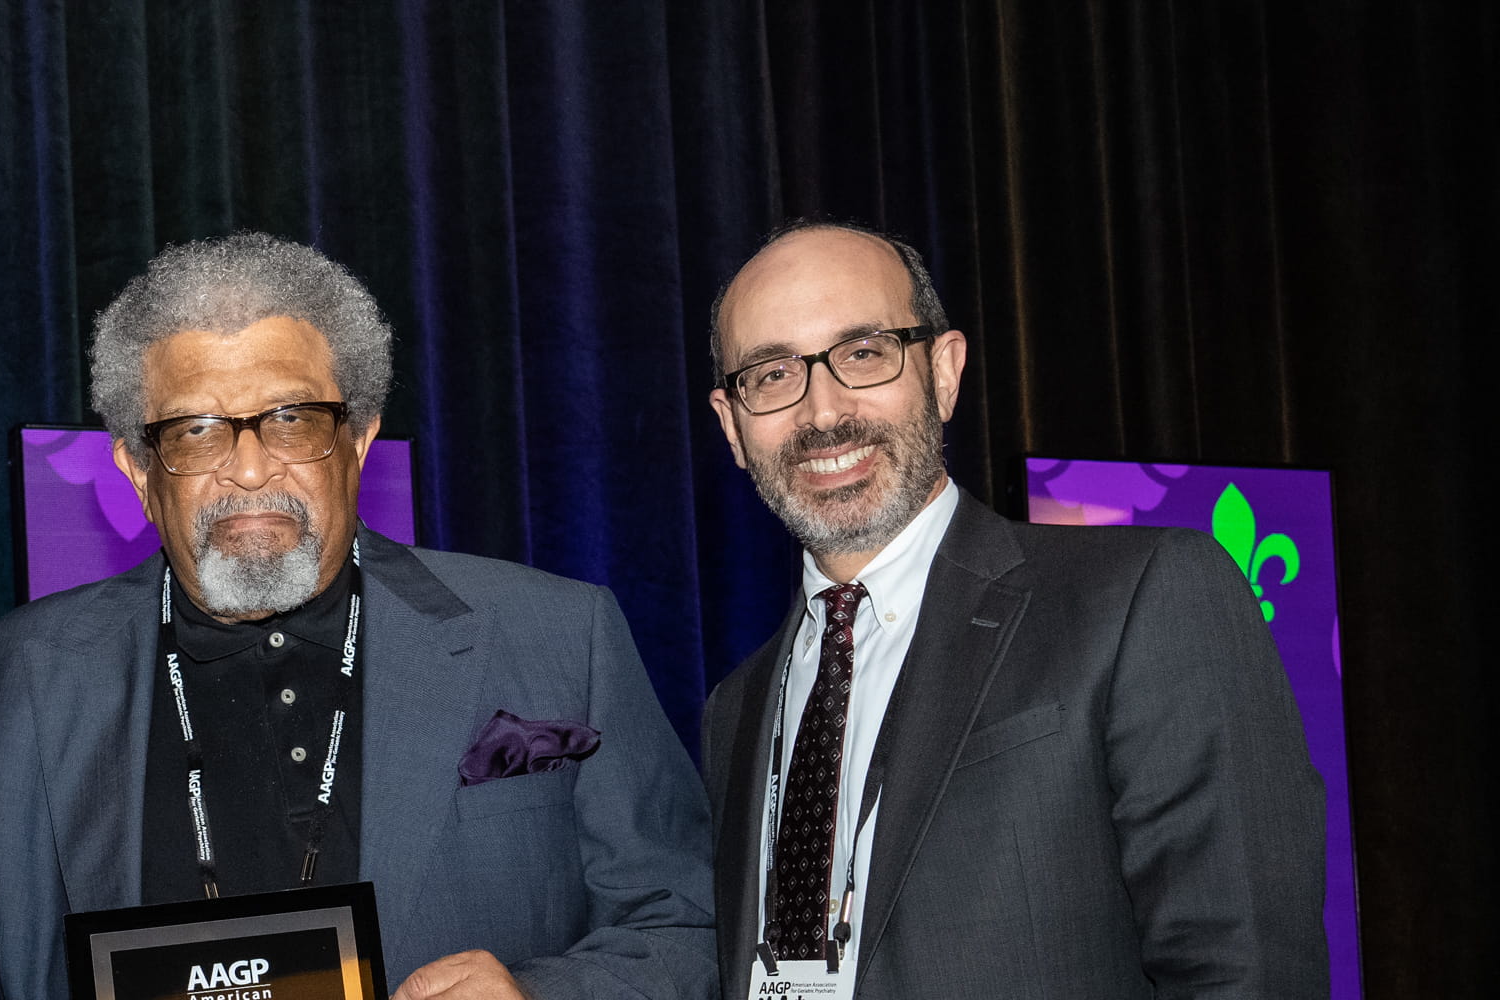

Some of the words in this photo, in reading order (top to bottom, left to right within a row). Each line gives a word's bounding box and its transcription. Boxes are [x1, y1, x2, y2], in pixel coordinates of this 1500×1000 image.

[167, 653, 183, 688] AAGP
[341, 640, 356, 677] AAGP
[318, 762, 335, 804] AAGP
[187, 958, 269, 991] AAGP
[759, 982, 791, 994] AAGP
